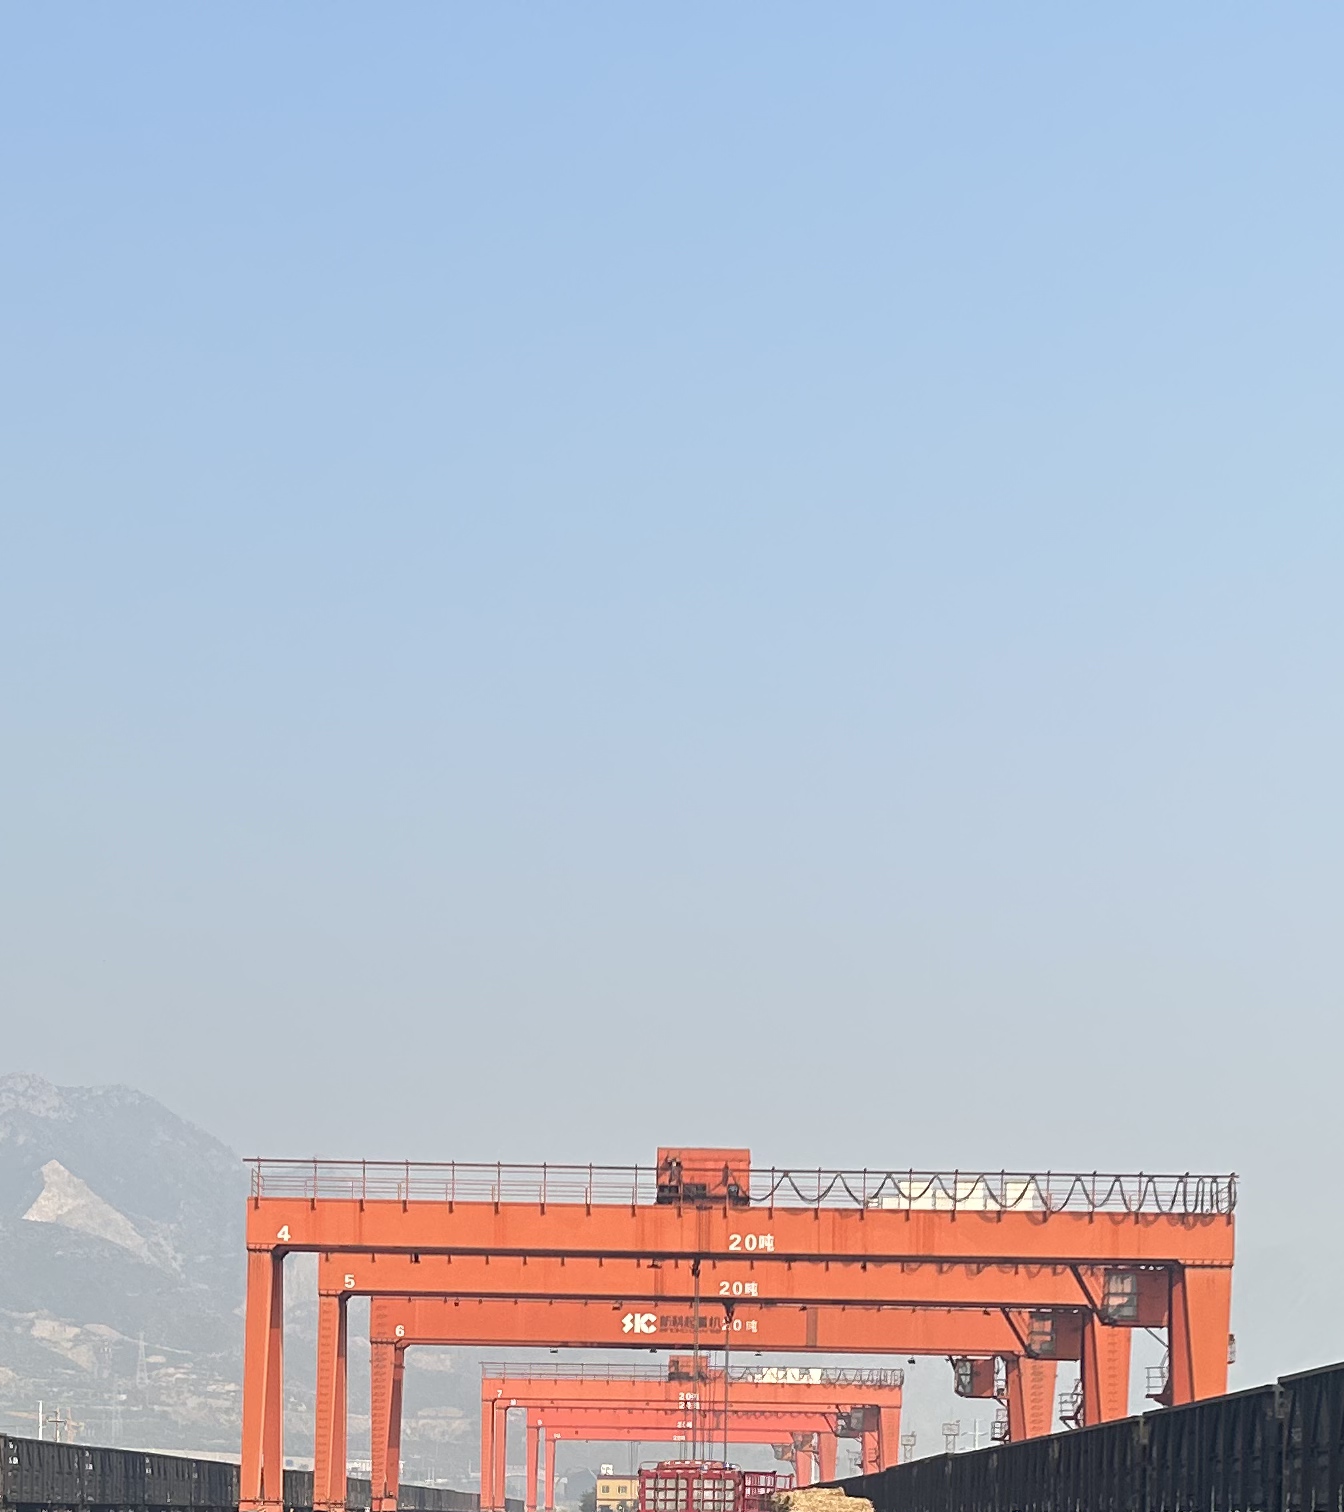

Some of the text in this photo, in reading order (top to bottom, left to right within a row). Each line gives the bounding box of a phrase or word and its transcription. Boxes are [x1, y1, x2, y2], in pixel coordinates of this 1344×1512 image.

[277, 1225, 291, 1241] 4
[729, 1233, 775, 1252] 20吨
[344, 1274, 356, 1289] 5
[719, 1281, 759, 1296] 20吨
[395, 1325, 405, 1337] 6
[497, 1389, 503, 1398] 7
